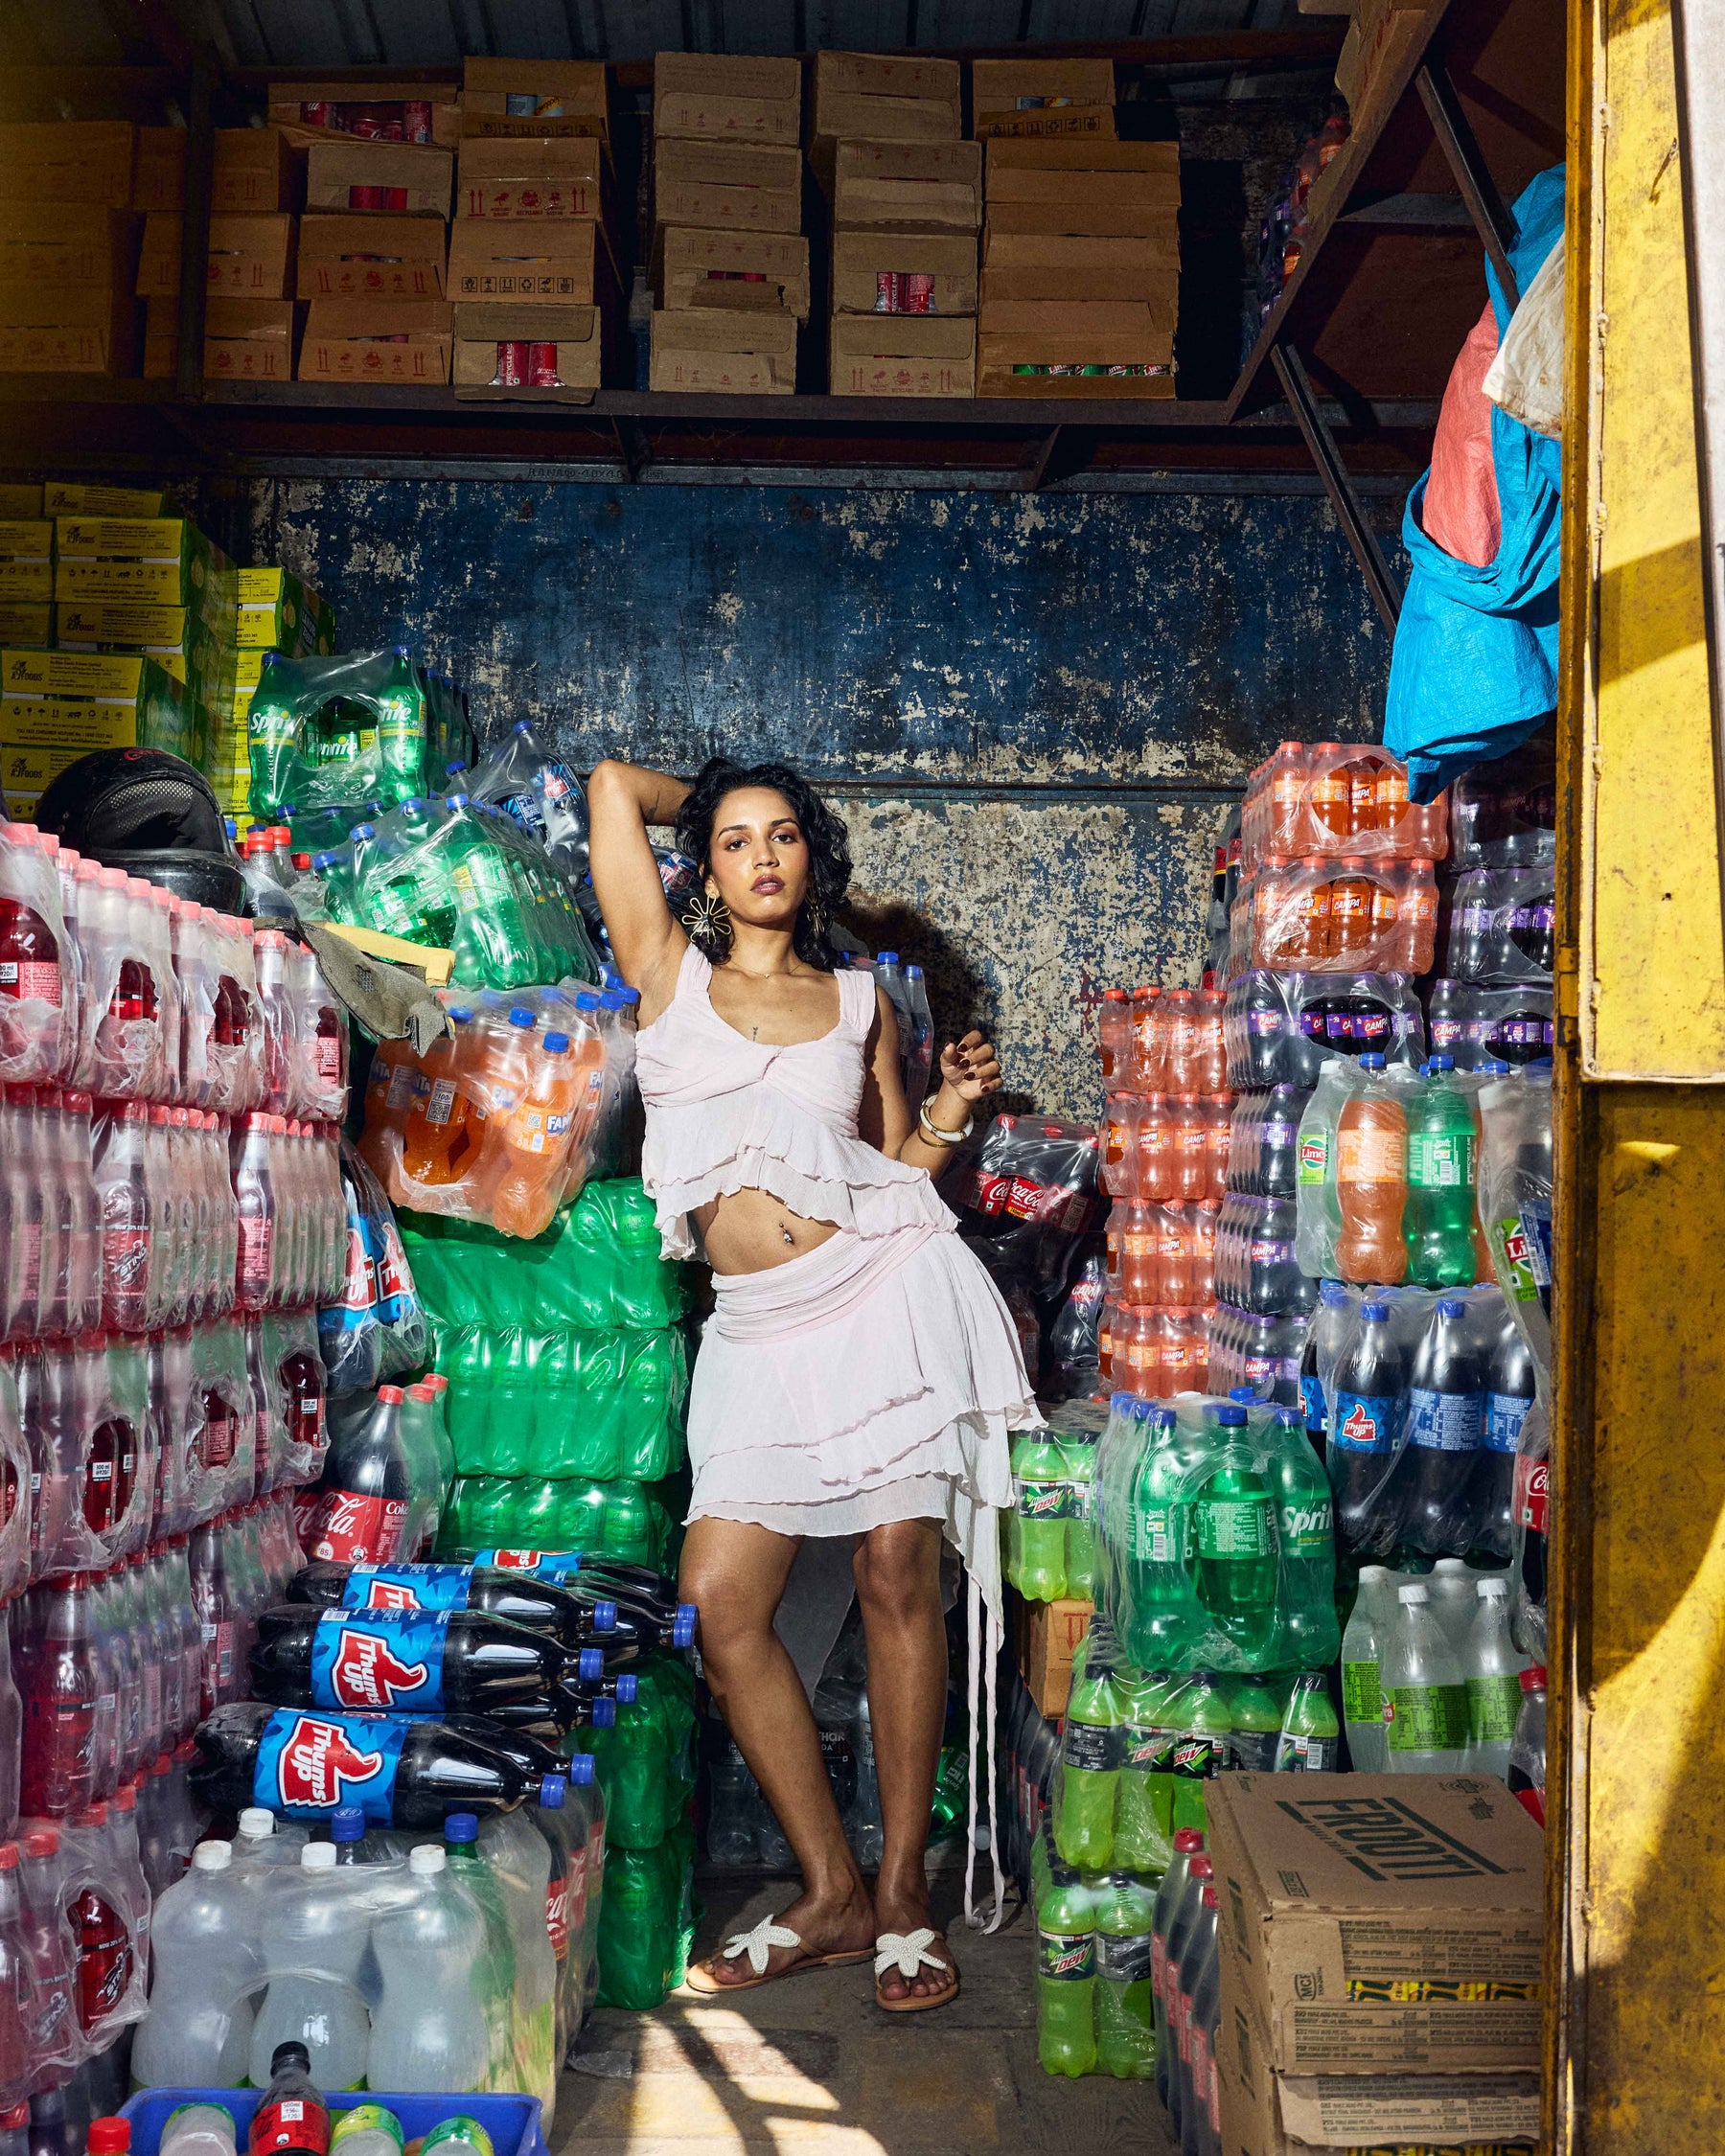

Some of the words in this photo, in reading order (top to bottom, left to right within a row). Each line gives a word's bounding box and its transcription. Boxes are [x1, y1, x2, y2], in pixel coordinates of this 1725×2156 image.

[1333, 898, 1360, 910] CAMPA
[1435, 1025, 1461, 1037] CAMPA
[546, 1114, 572, 1131] FAN
[1300, 1148, 1325, 1158] Limc
[1159, 1240, 1180, 1252] CAMPA
[1252, 1244, 1276, 1257] CAMPA
[1162, 1348, 1184, 1361] CAMPA
[1245, 1362, 1270, 1373] CAMPA
[1346, 1422, 1373, 1432] Thums
[356, 1641, 382, 1706] Thums
[311, 1727, 333, 1801] Thums
[1296, 1797, 1485, 1881] FROOTI
